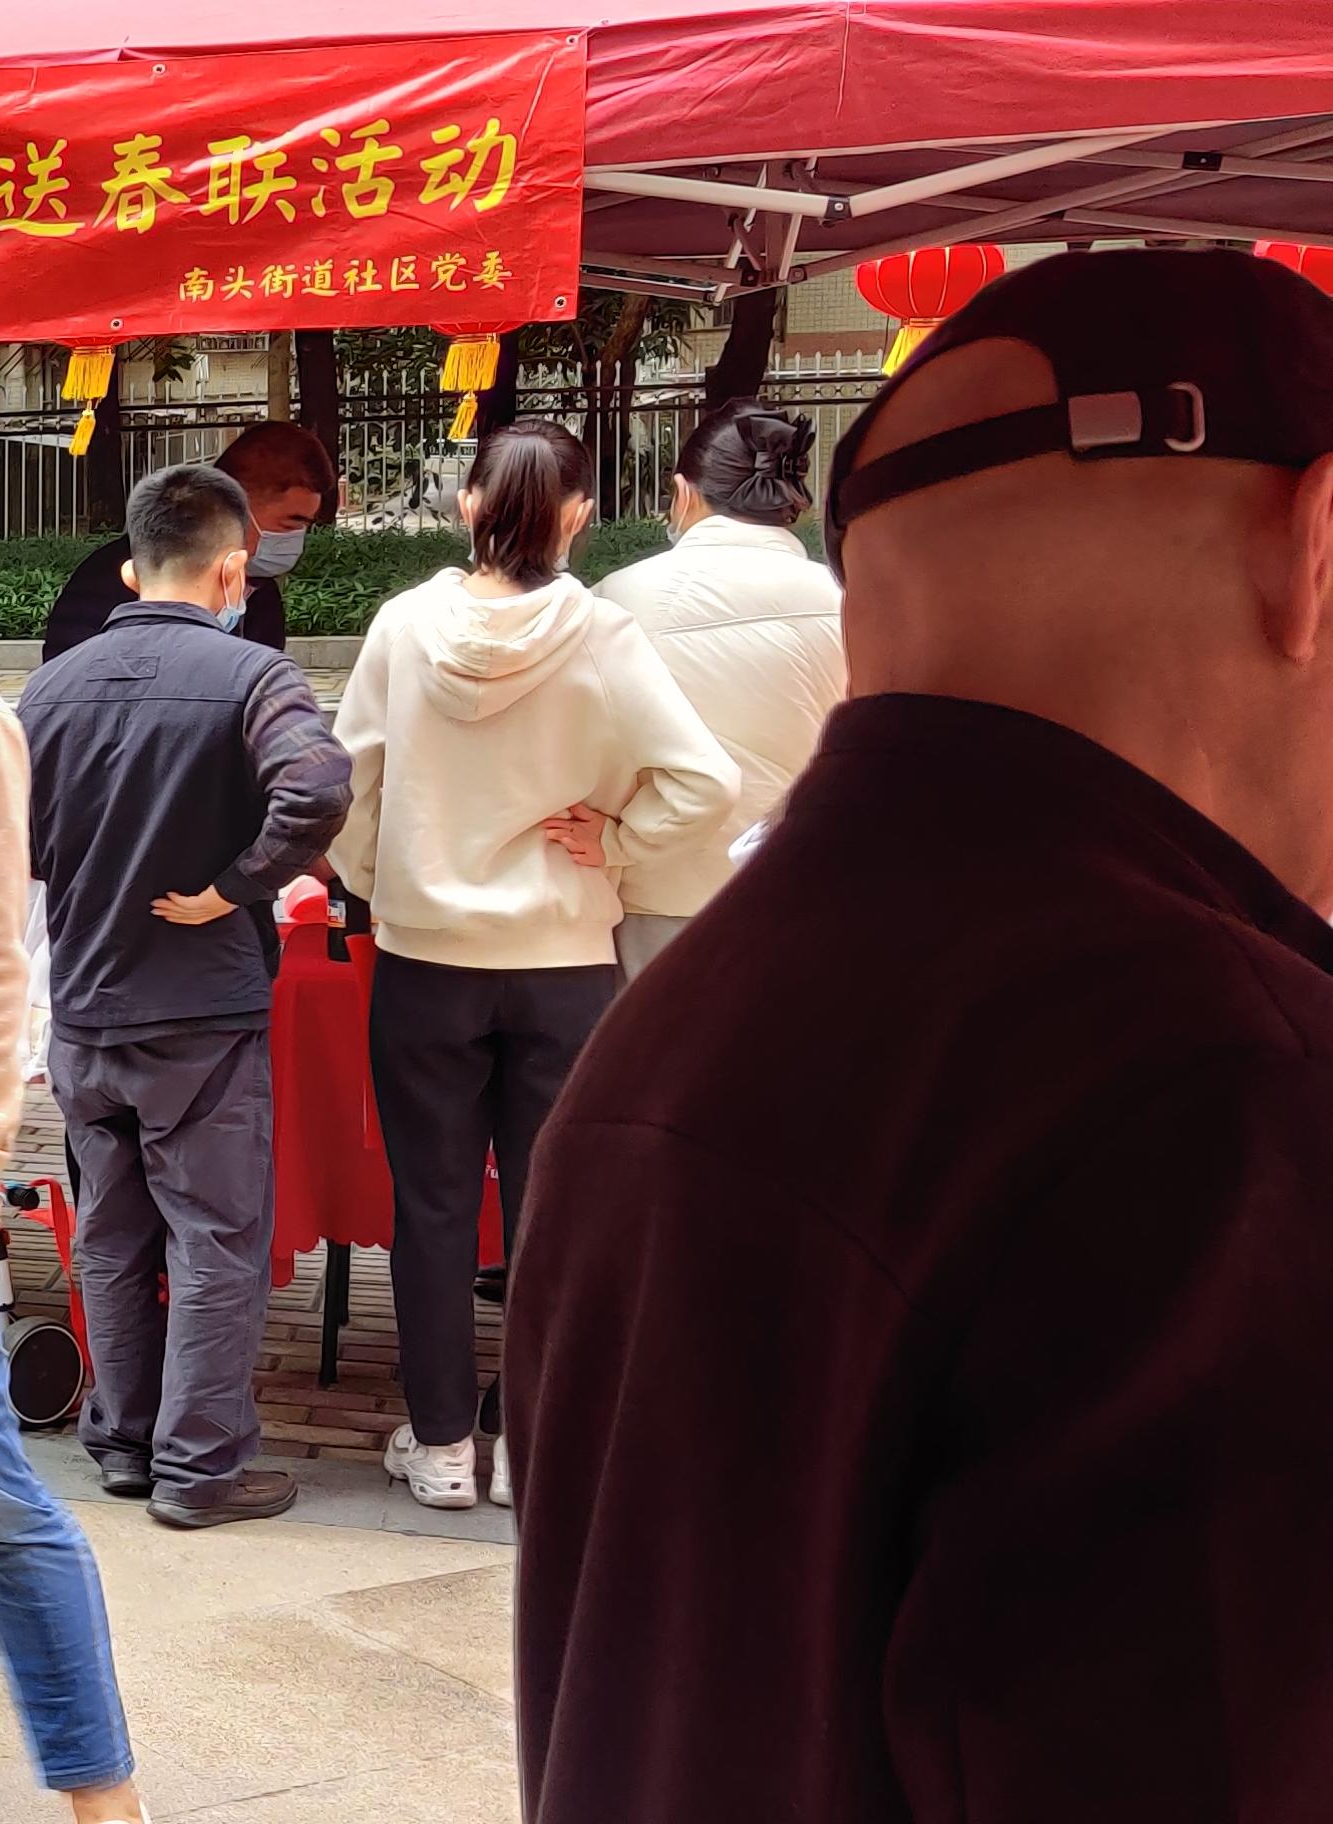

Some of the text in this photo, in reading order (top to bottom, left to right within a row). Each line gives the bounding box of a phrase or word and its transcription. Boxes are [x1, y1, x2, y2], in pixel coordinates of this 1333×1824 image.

[178, 250, 513, 303] 南头街道社区党委
